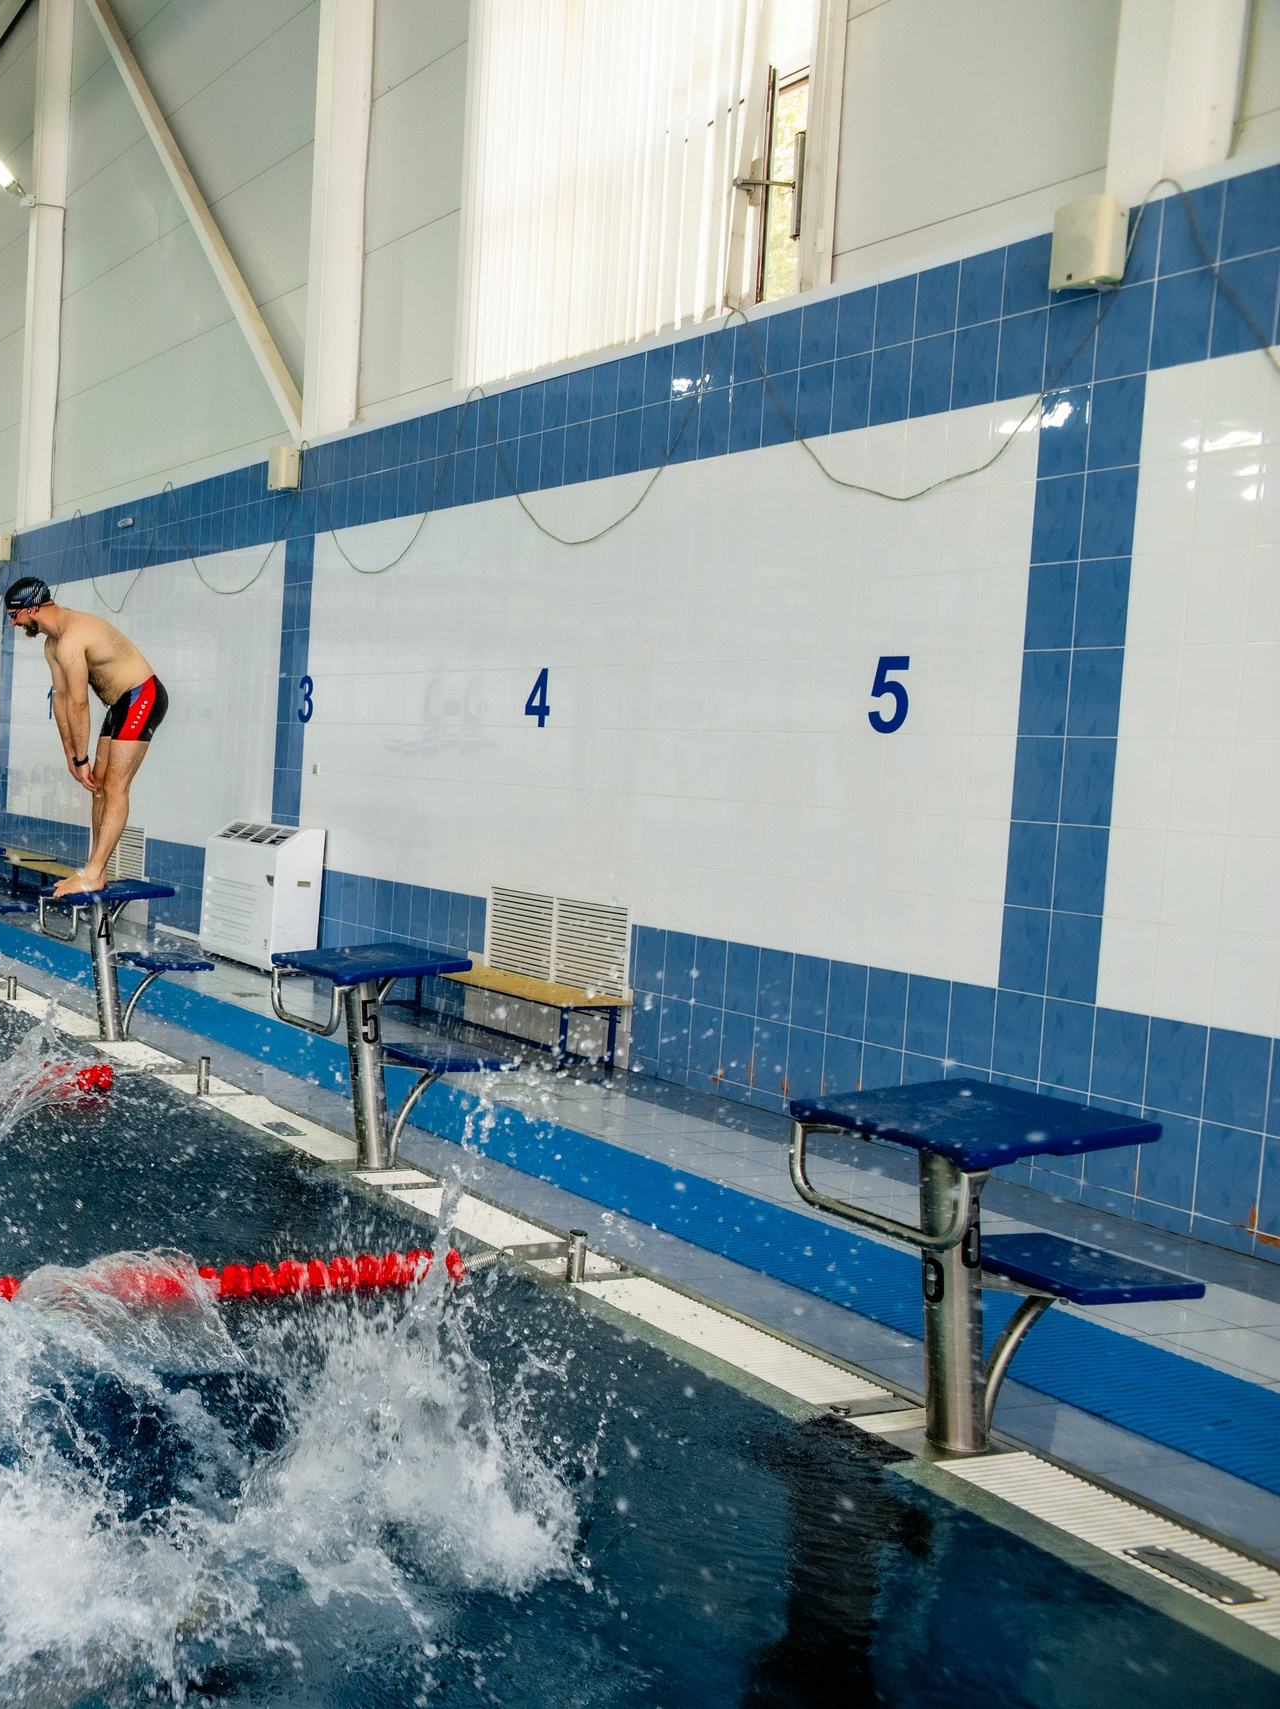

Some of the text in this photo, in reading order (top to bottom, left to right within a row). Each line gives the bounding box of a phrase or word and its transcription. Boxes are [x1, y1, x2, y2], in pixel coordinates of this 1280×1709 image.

[298, 675, 313, 723] 3
[524, 668, 551, 728] 4
[868, 655, 910, 734] 5
[97, 912, 111, 945] 4
[361, 998, 379, 1044] 5
